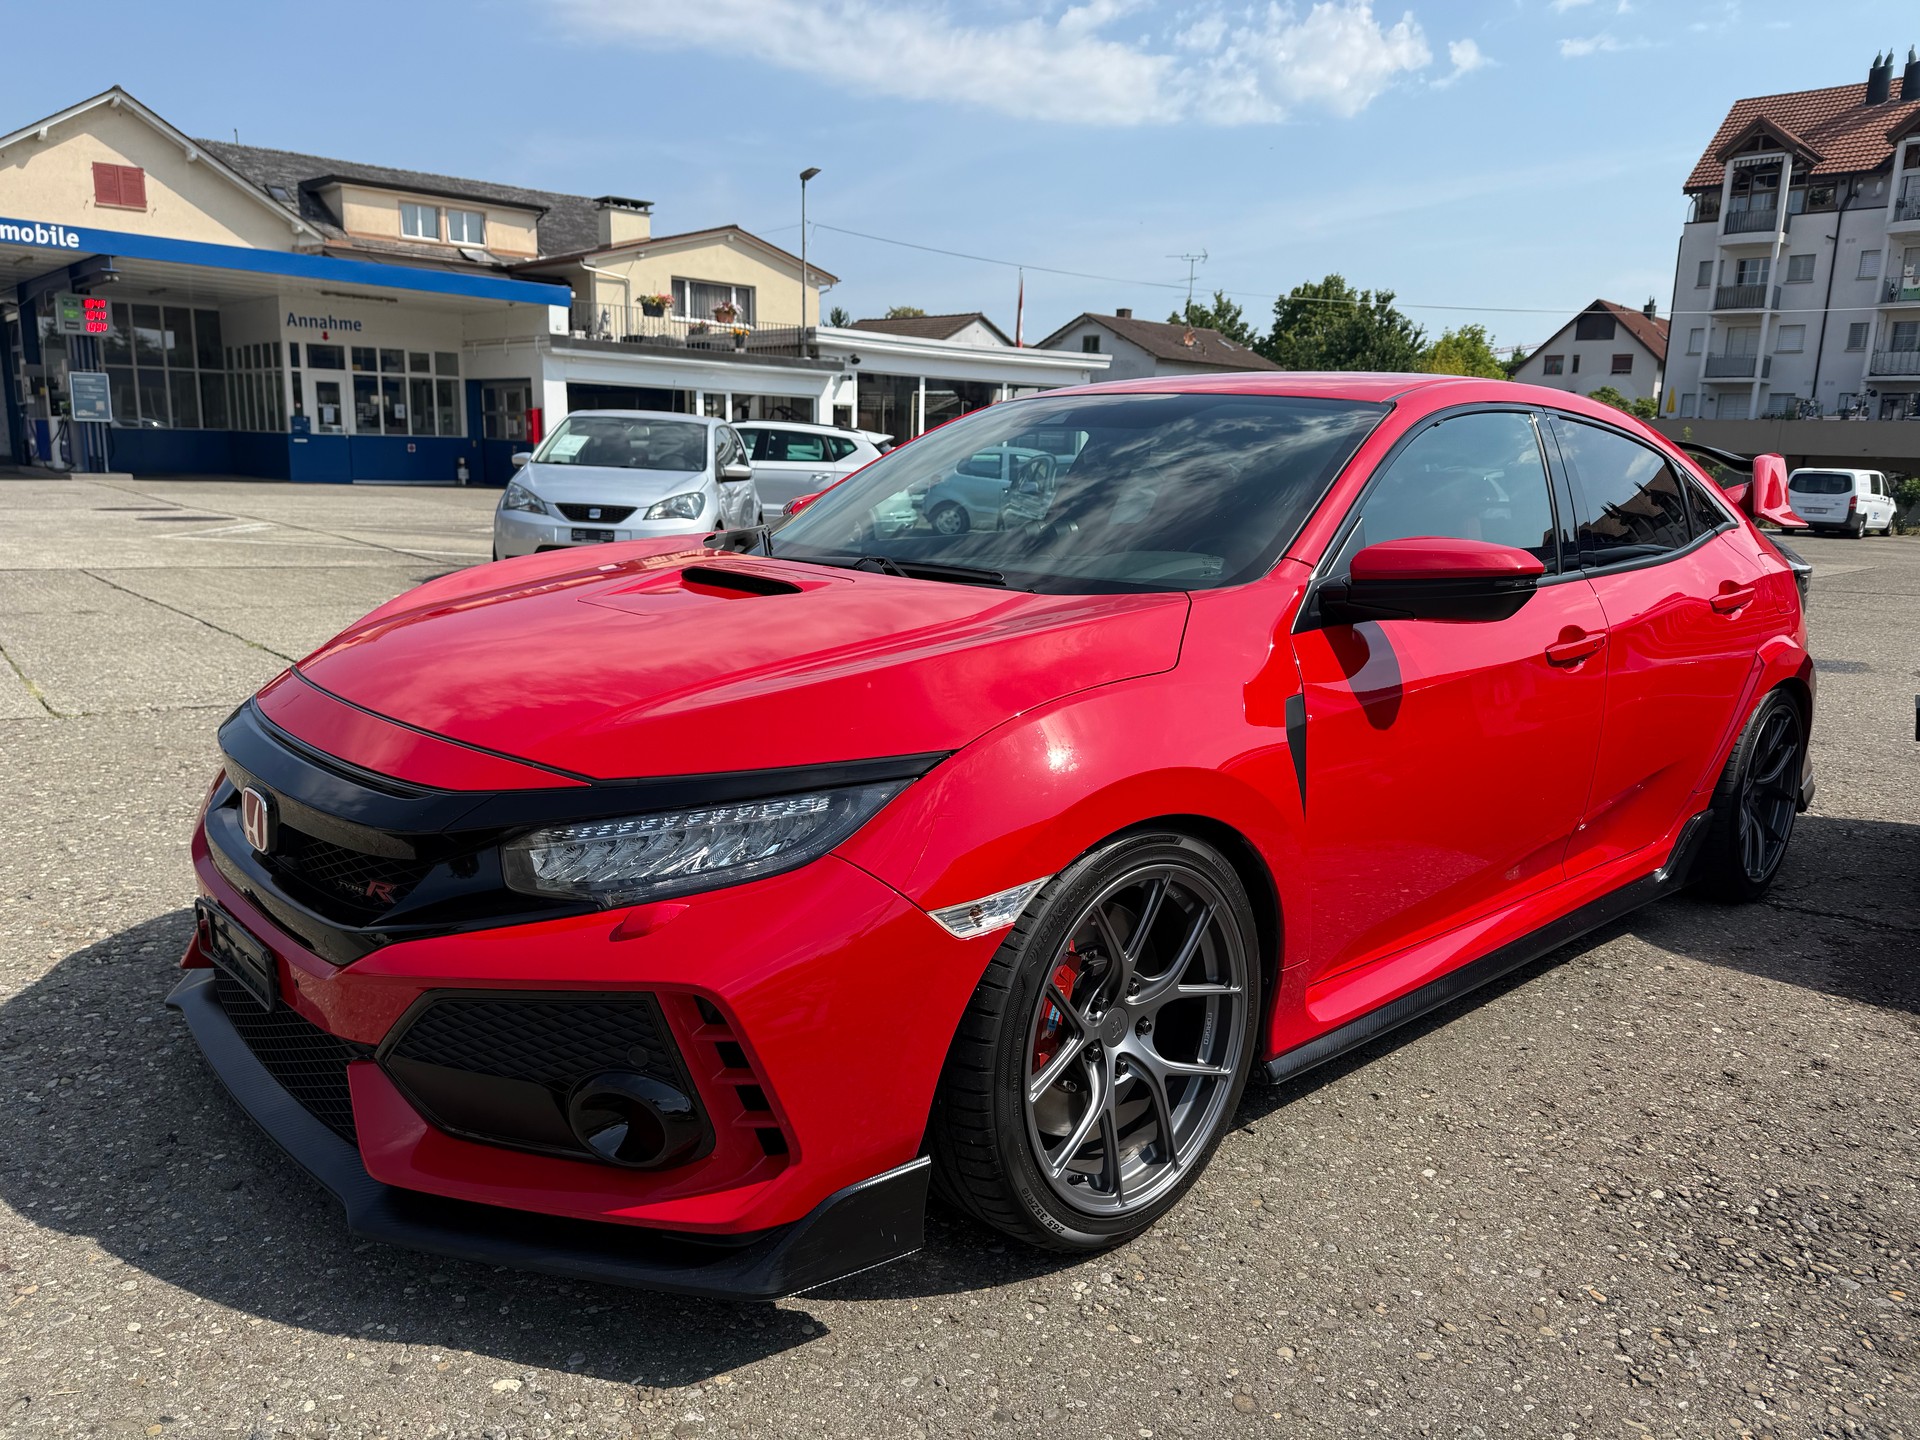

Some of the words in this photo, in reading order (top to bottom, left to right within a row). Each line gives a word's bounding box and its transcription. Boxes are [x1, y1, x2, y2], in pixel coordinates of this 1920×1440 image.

[0, 223, 80, 248] mobile
[287, 312, 362, 332] Annahme
[365, 880, 397, 904] R
[1203, 1012, 1213, 1045] FORGED
[1021, 1187, 1065, 1234] 265/35ZR18
